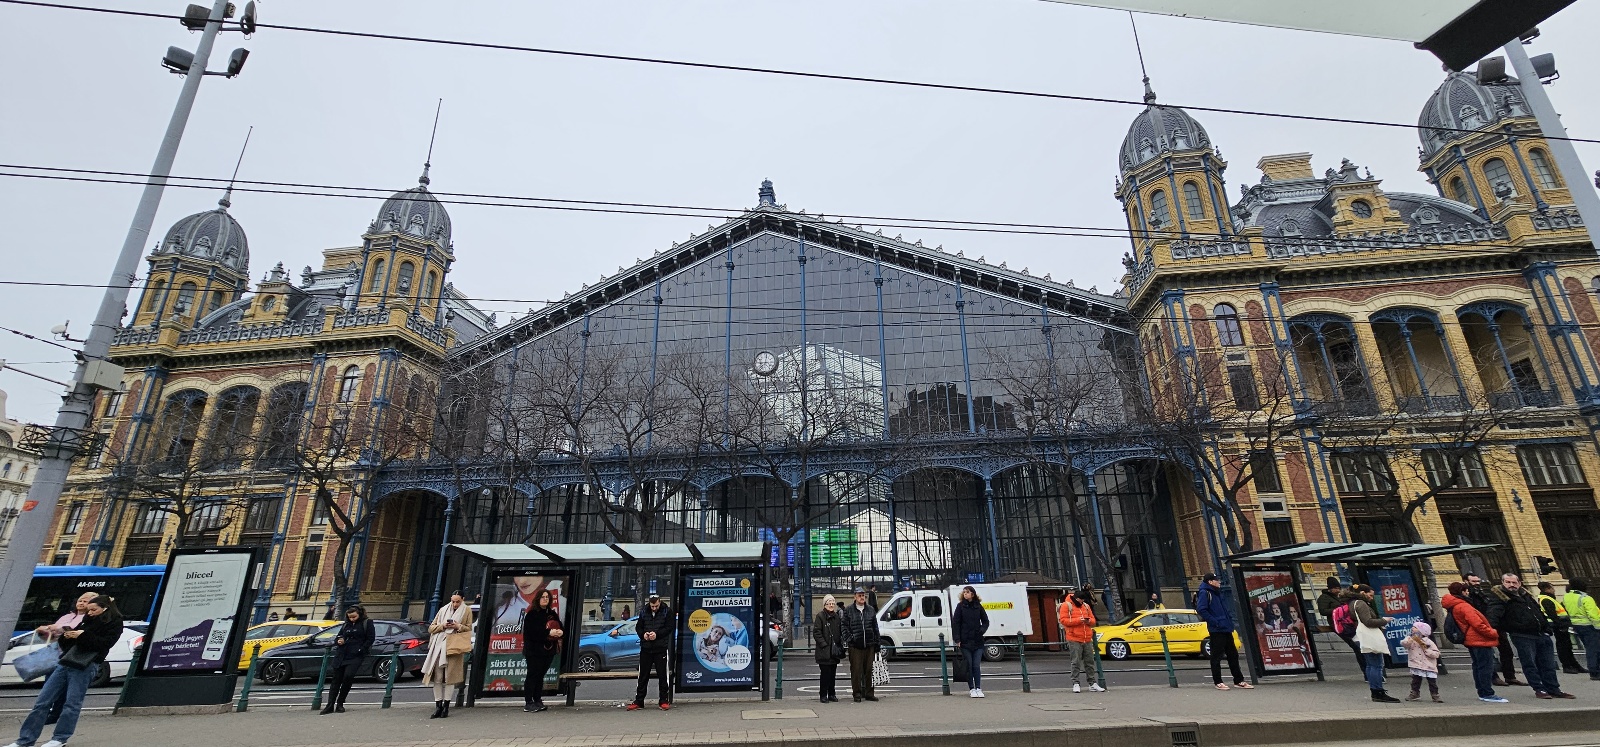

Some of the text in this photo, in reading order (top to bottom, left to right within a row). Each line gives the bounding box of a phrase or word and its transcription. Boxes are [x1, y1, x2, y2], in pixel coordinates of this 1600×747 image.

[185, 571, 214, 580] bliccel
[1384, 587, 1406, 600] 99%
[704, 597, 750, 606] TANULÁSÁT!
[1385, 600, 1408, 611] NEM
[1390, 614, 1424, 627] MIGRÁNS-
[1386, 627, 1413, 639] GETTÓK
[490, 658, 528, 668] SÜSS ÉS FŐ
[489, 668, 508, 676] MINT
[508, 668, 514, 676] A
